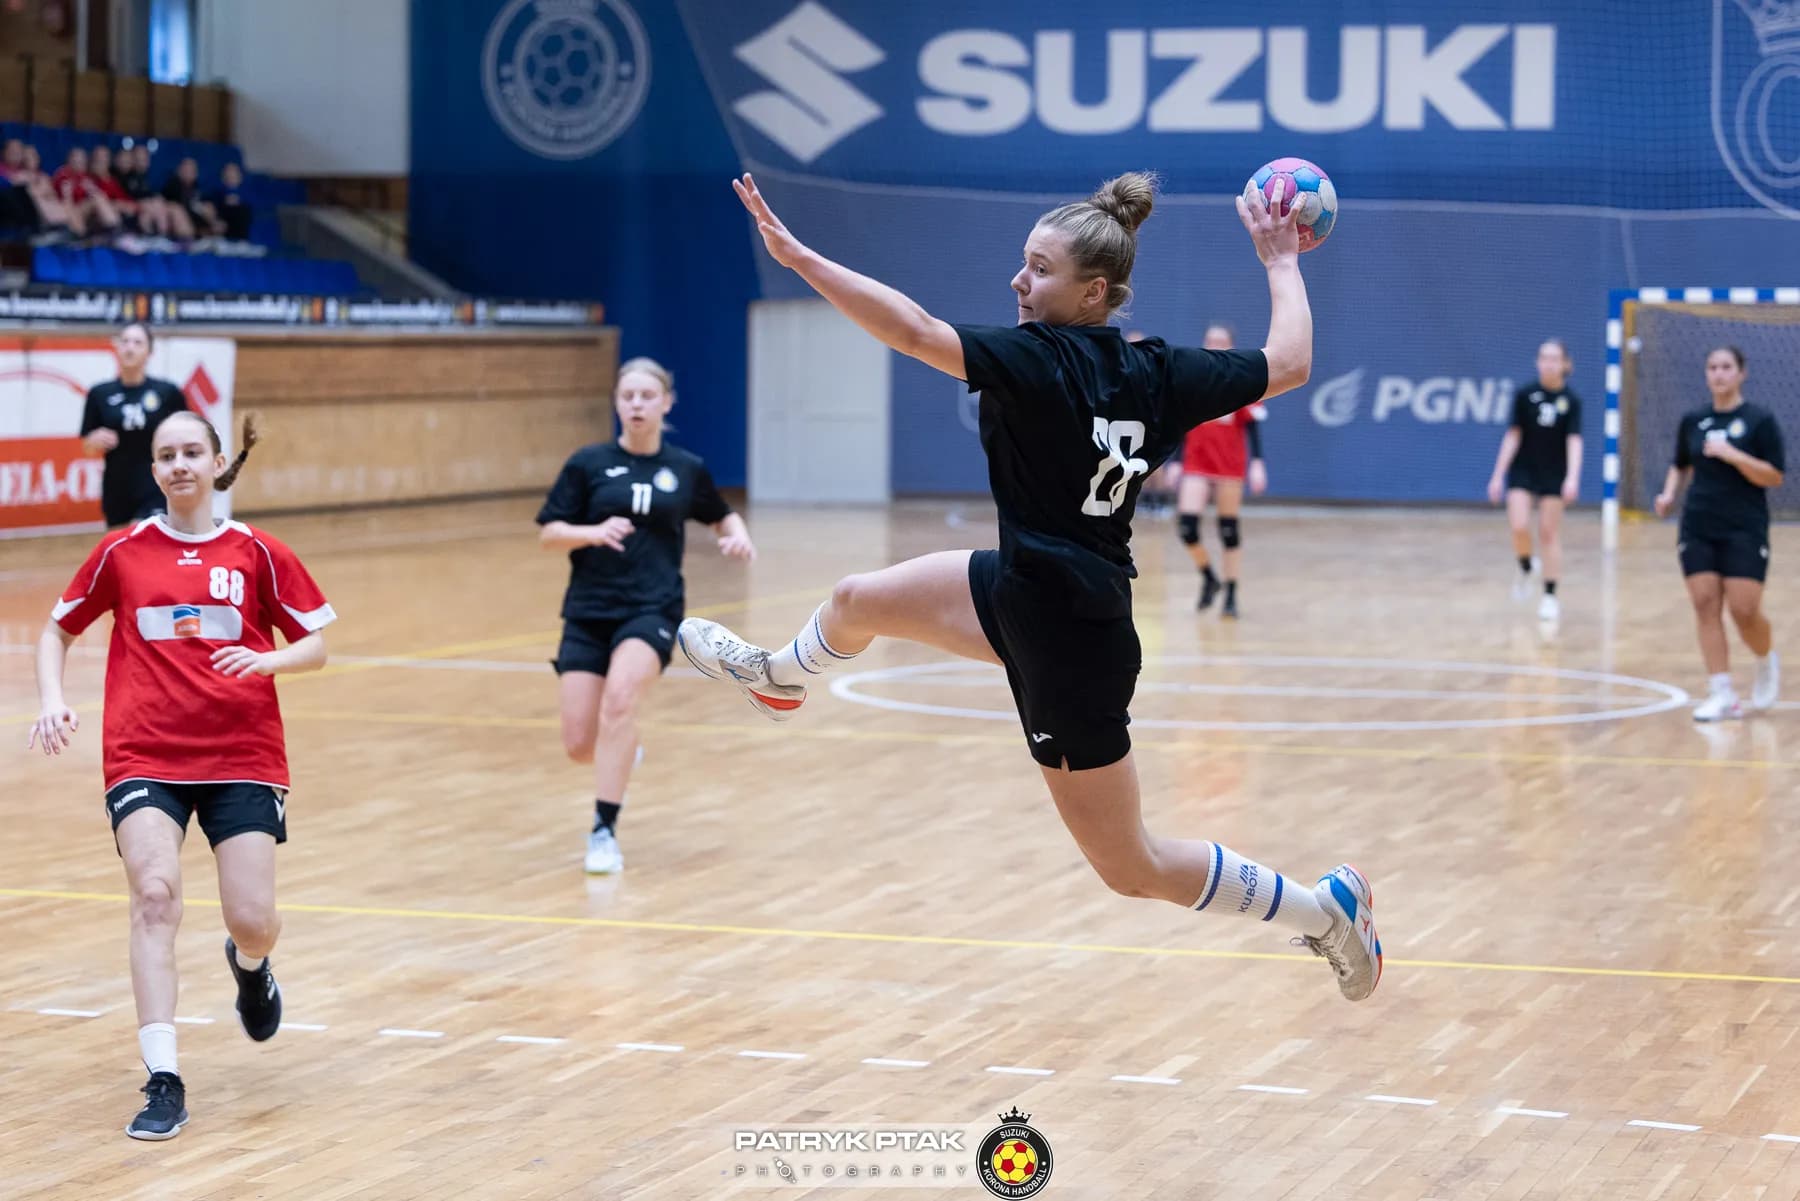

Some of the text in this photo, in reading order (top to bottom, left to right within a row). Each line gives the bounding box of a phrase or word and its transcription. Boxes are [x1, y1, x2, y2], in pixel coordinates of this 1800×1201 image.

[917, 24, 1556, 134] SUZUKI
[1081, 416, 1149, 517] 26
[631, 482, 652, 515] 11
[209, 566, 245, 607] 88
[1238, 865, 1258, 913] KUBOTA
